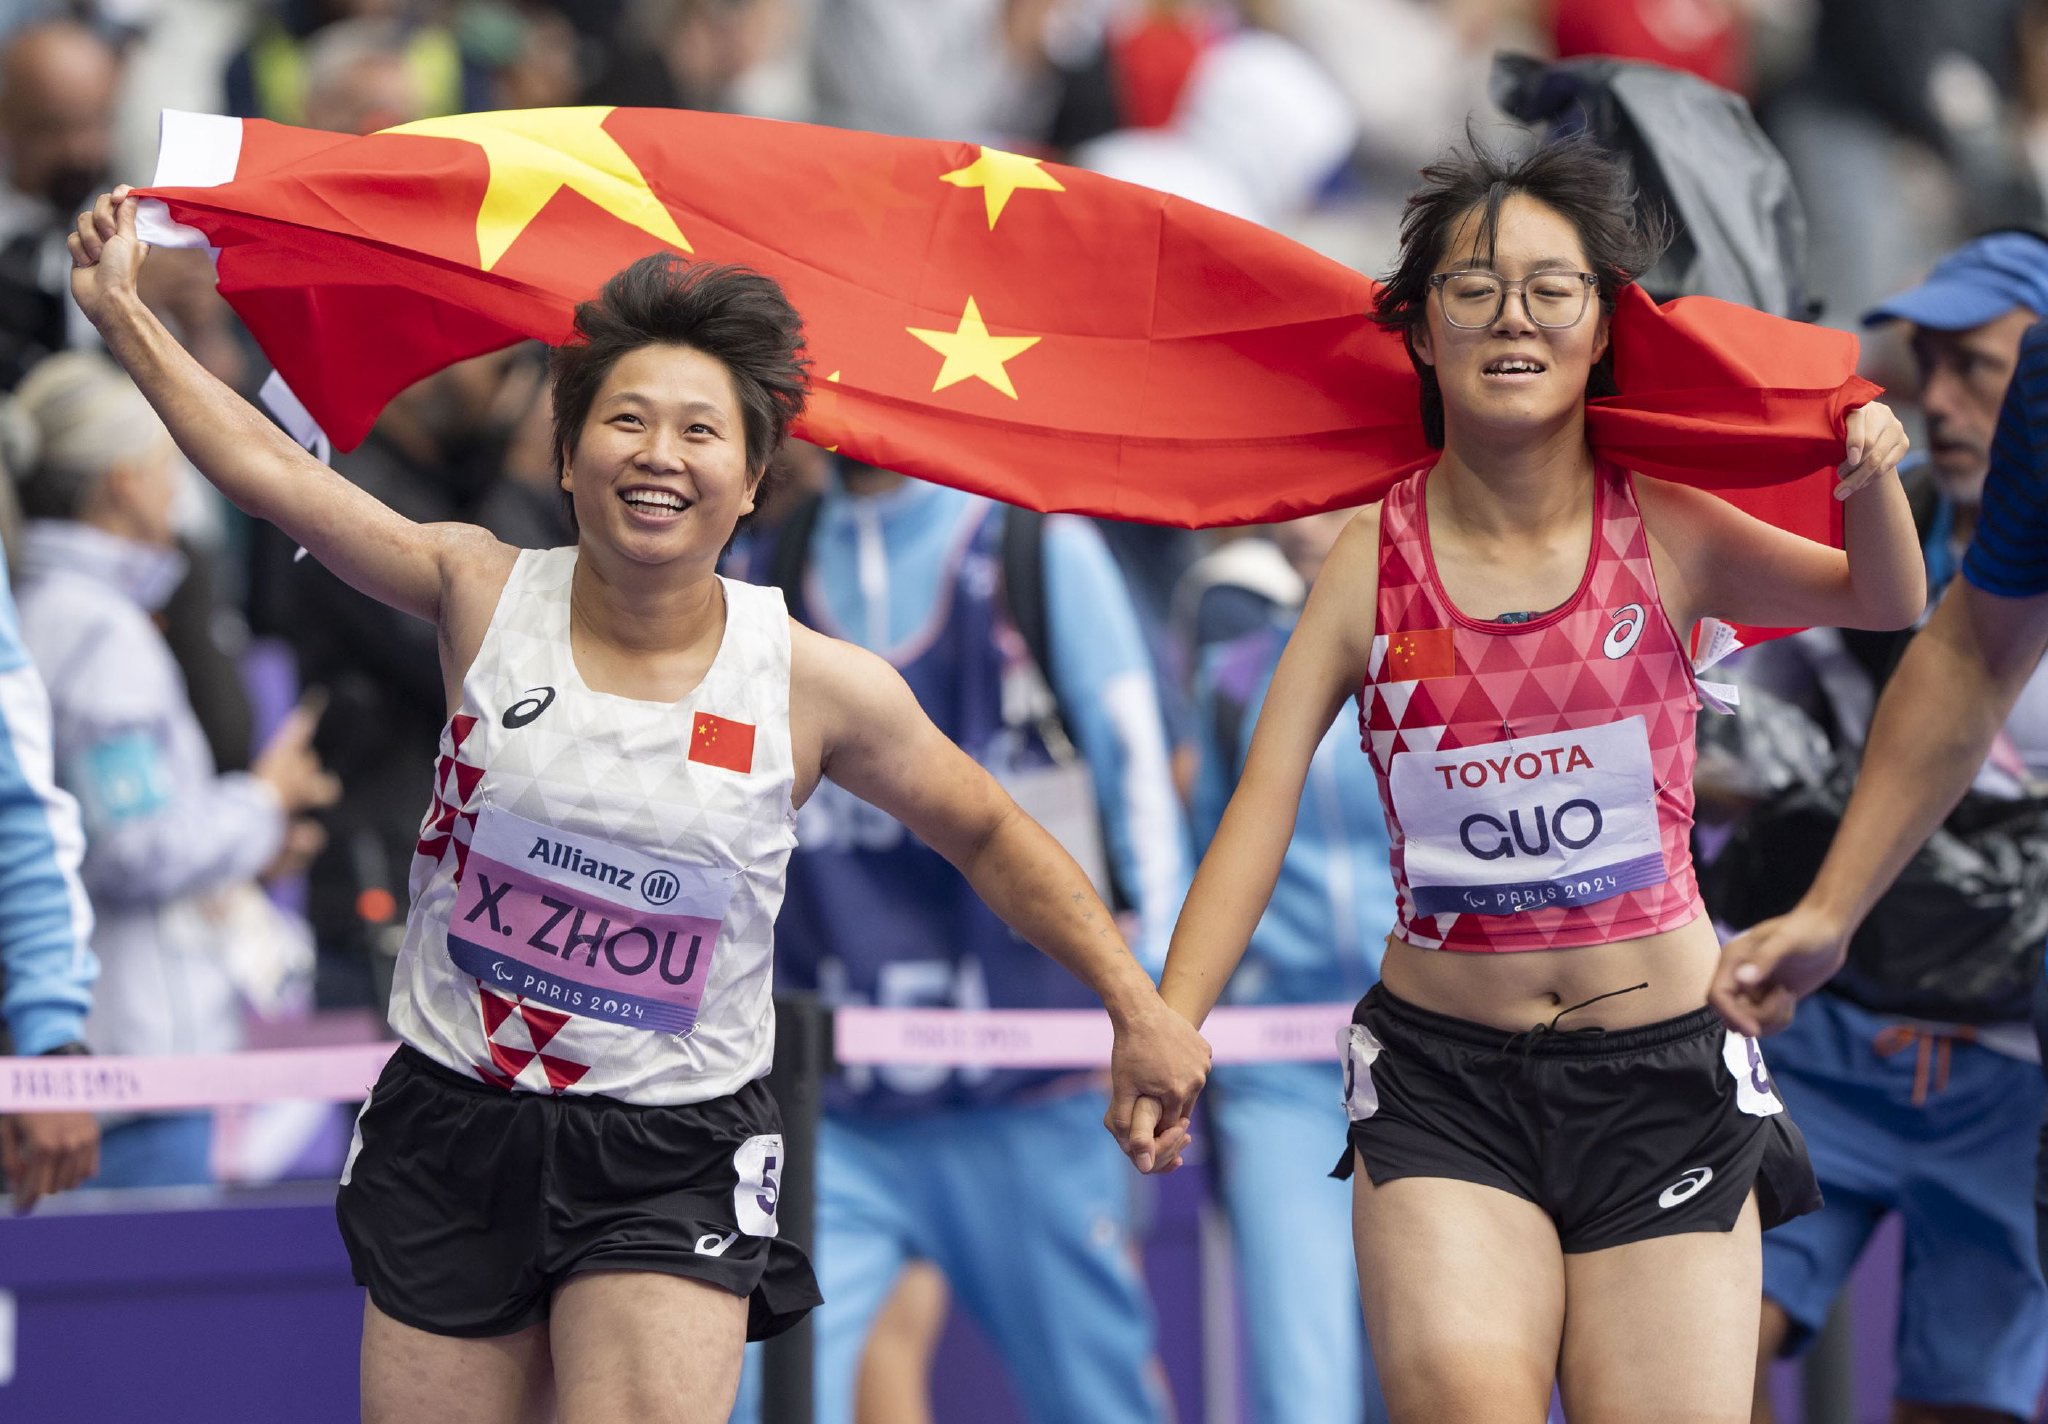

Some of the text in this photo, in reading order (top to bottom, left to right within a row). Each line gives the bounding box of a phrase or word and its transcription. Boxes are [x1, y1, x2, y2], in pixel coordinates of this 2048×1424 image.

[1435, 744, 1595, 790] TOYOTA
[1459, 798, 1603, 861] GUO
[527, 836, 636, 891] Allianz
[1564, 875, 1617, 899] 2024
[463, 873, 702, 985] X. ZHOU
[590, 996, 645, 1020] 2024
[756, 1156, 778, 1216] 5
